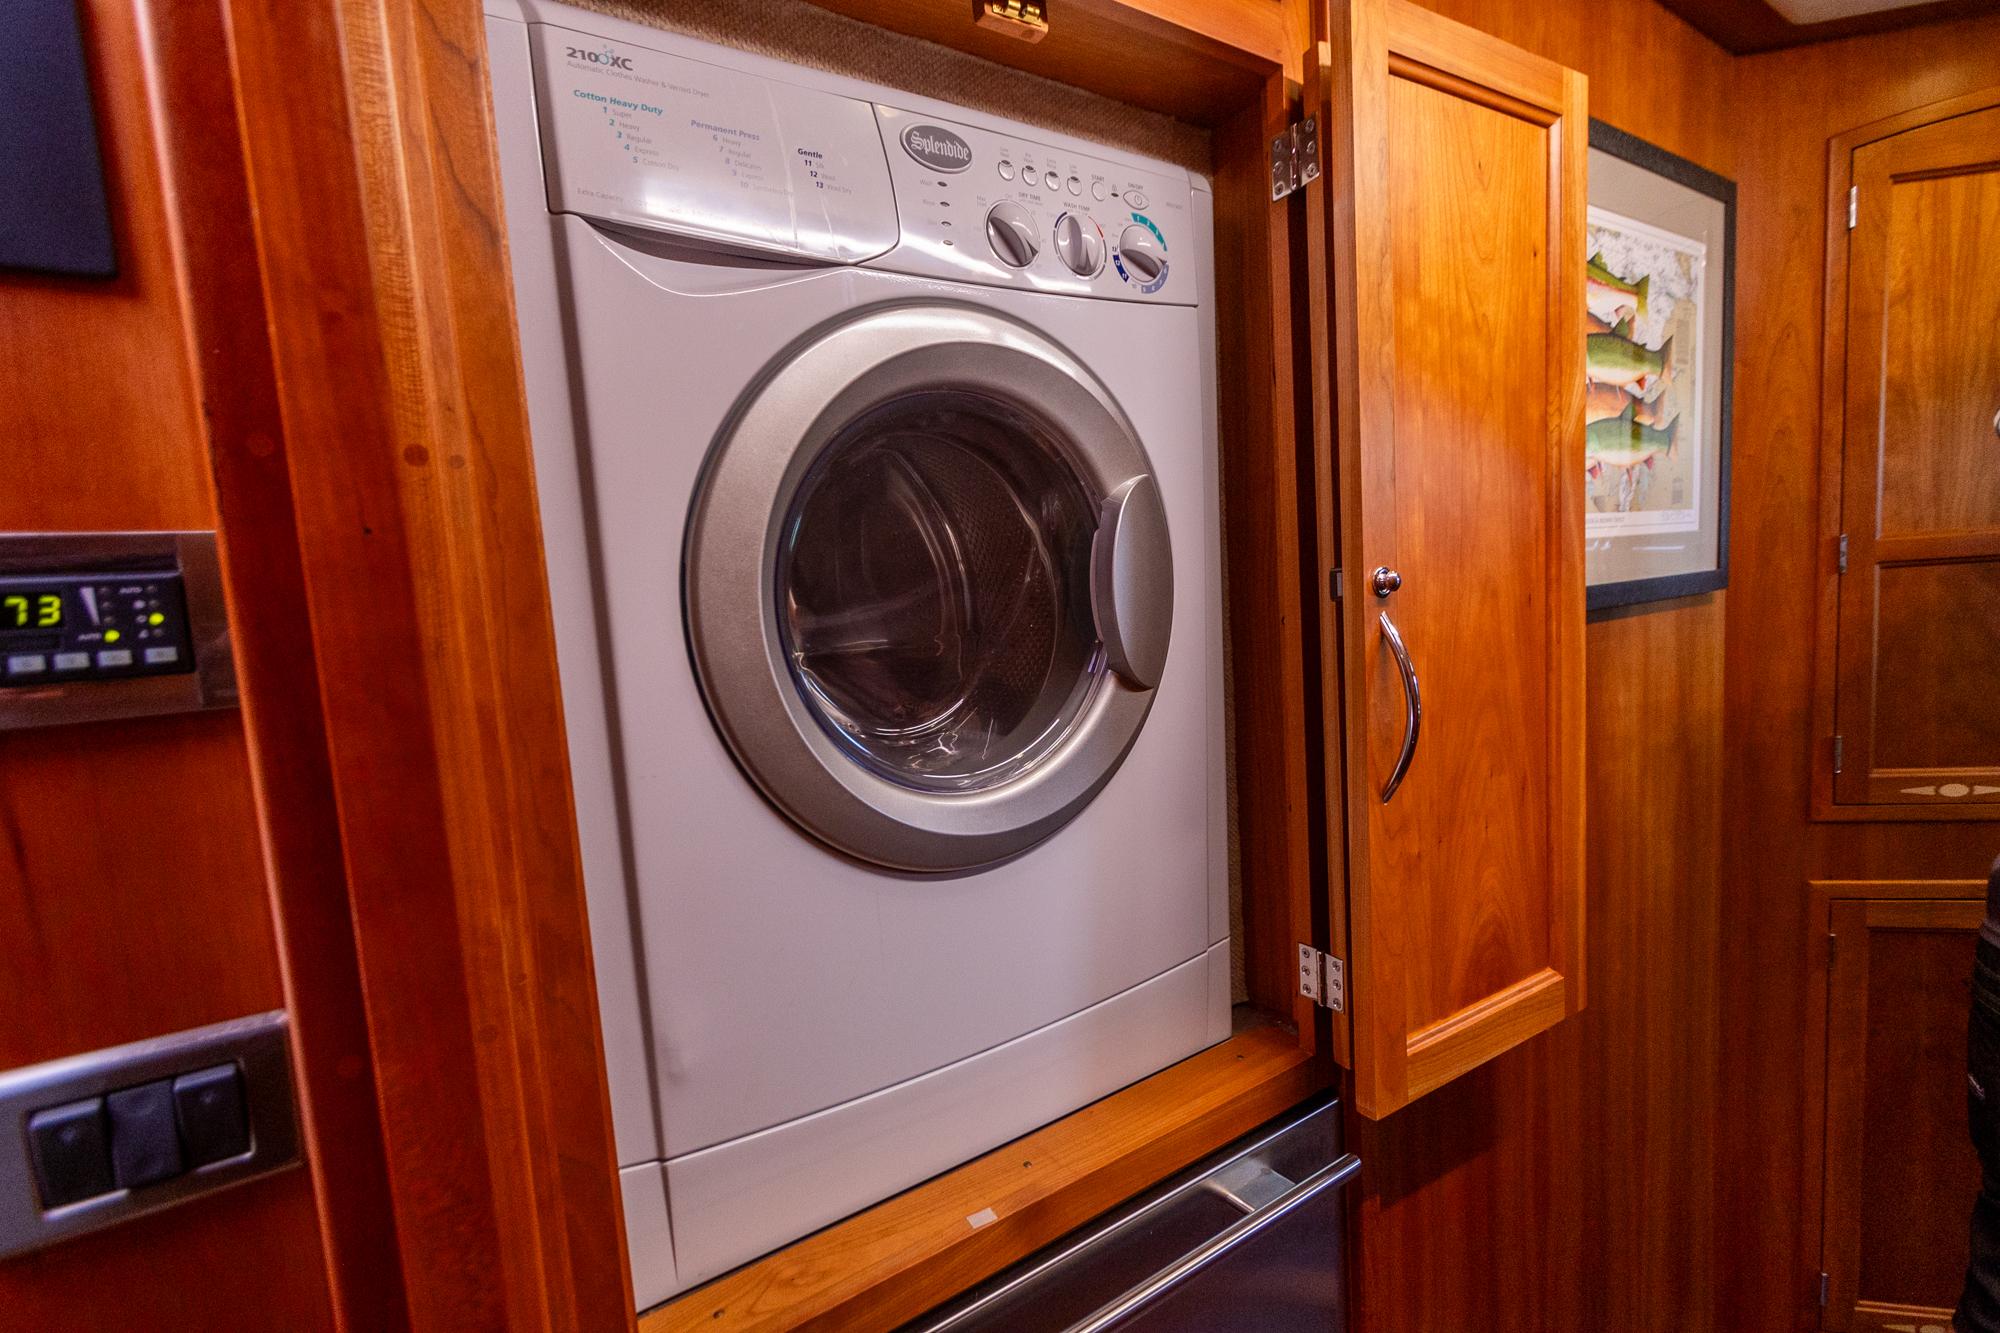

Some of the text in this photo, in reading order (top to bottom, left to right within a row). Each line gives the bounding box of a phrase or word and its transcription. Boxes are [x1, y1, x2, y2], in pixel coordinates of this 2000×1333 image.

[573, 89, 664, 116] Cotton Heavy Duty
[602, 106, 608, 114] 1
[609, 118, 640, 131] 2 Heavy
[691, 119, 760, 141] Permanent Press
[624, 143, 630, 151] 4
[910, 130, 969, 160] Splendide
[797, 147, 823, 159] Gentle
[633, 156, 639, 164] 5
[810, 170, 818, 178] 12
[816, 181, 824, 189] 13
[4, 594, 62, 627] 73
